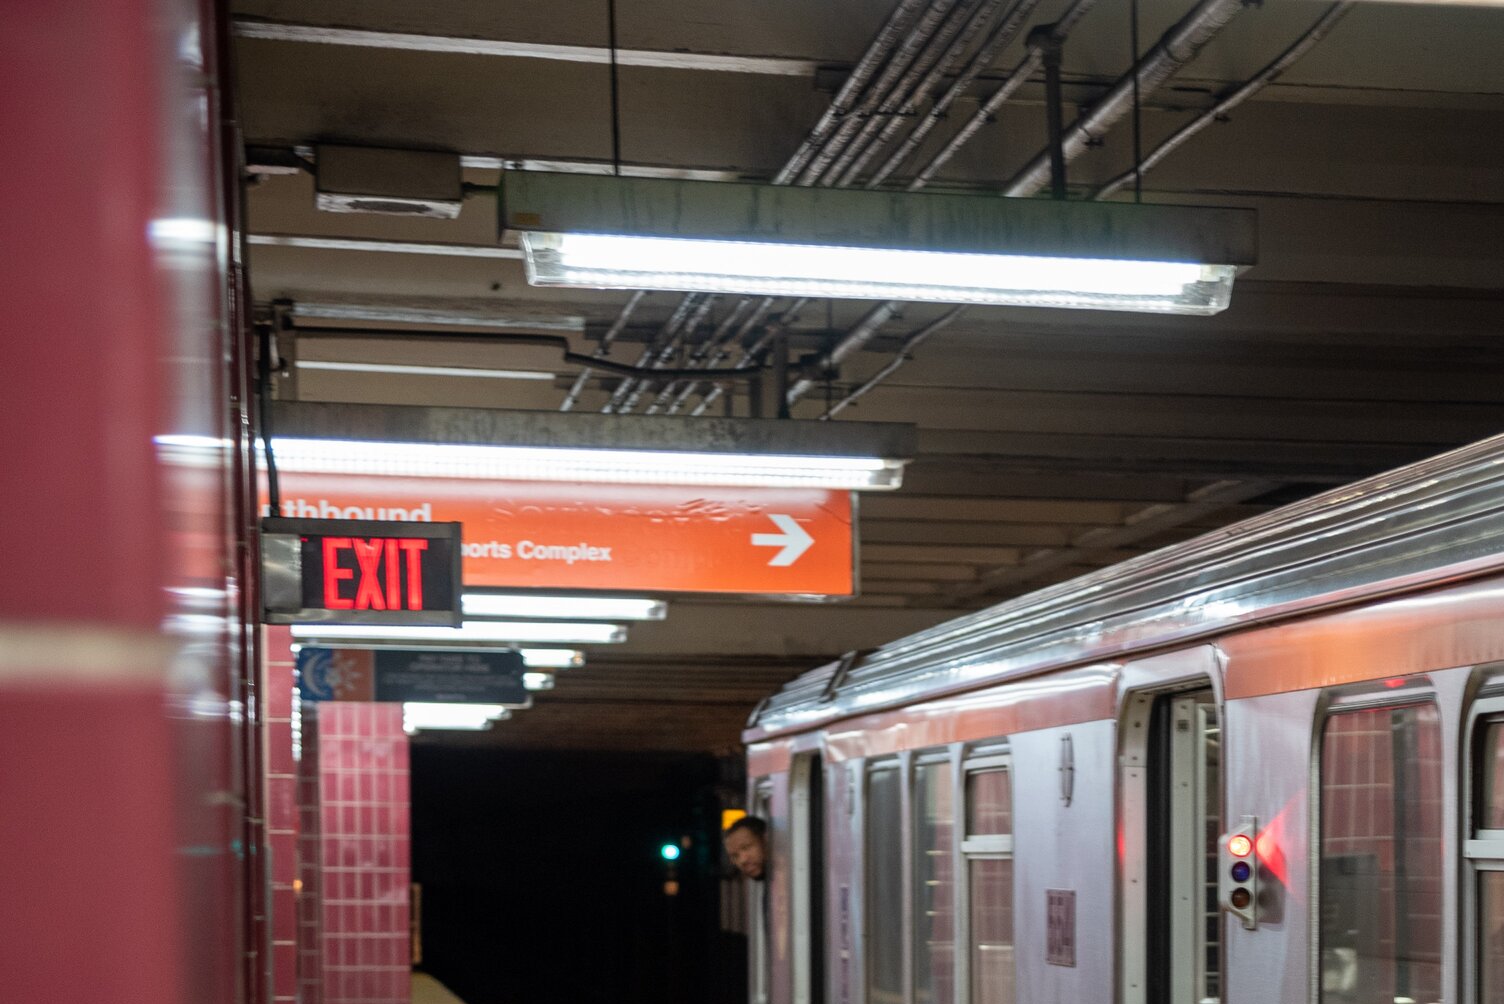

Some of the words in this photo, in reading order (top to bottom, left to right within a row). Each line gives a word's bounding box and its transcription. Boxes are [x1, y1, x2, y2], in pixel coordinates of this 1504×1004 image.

[261, 498, 432, 521] thbound
[516, 540, 613, 565] Complex
[321, 537, 428, 611] EXIT
